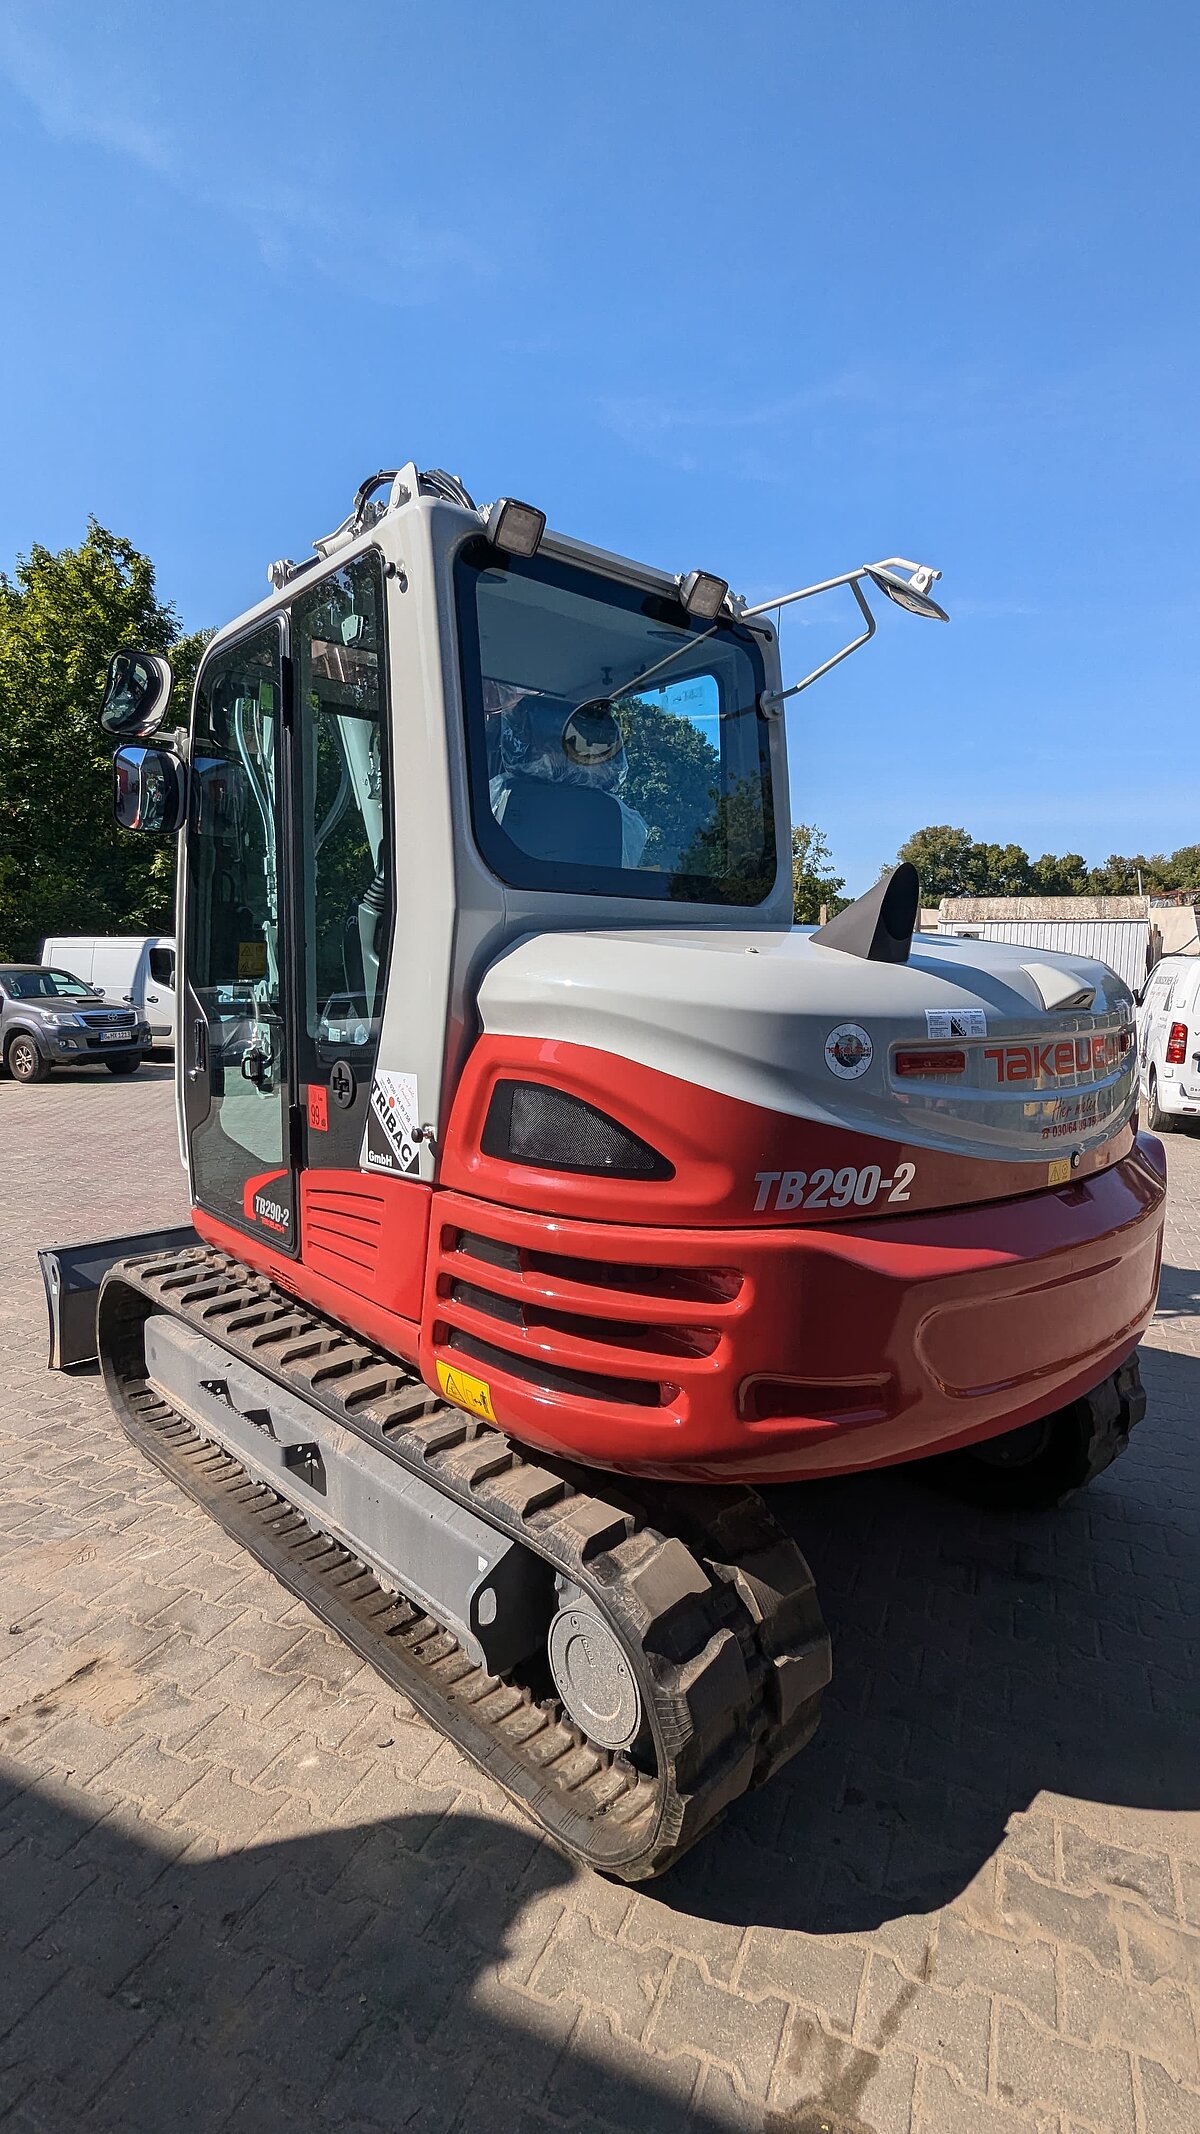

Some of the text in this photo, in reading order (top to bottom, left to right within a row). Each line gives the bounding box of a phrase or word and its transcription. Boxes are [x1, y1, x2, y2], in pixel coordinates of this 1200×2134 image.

[311, 1104, 320, 1125] 99
[371, 1078, 412, 1162] TRIBAC
[368, 1150, 392, 1167] GmbH
[753, 1162, 916, 1211] TB290-2
[255, 1195, 290, 1227] TB290-2
